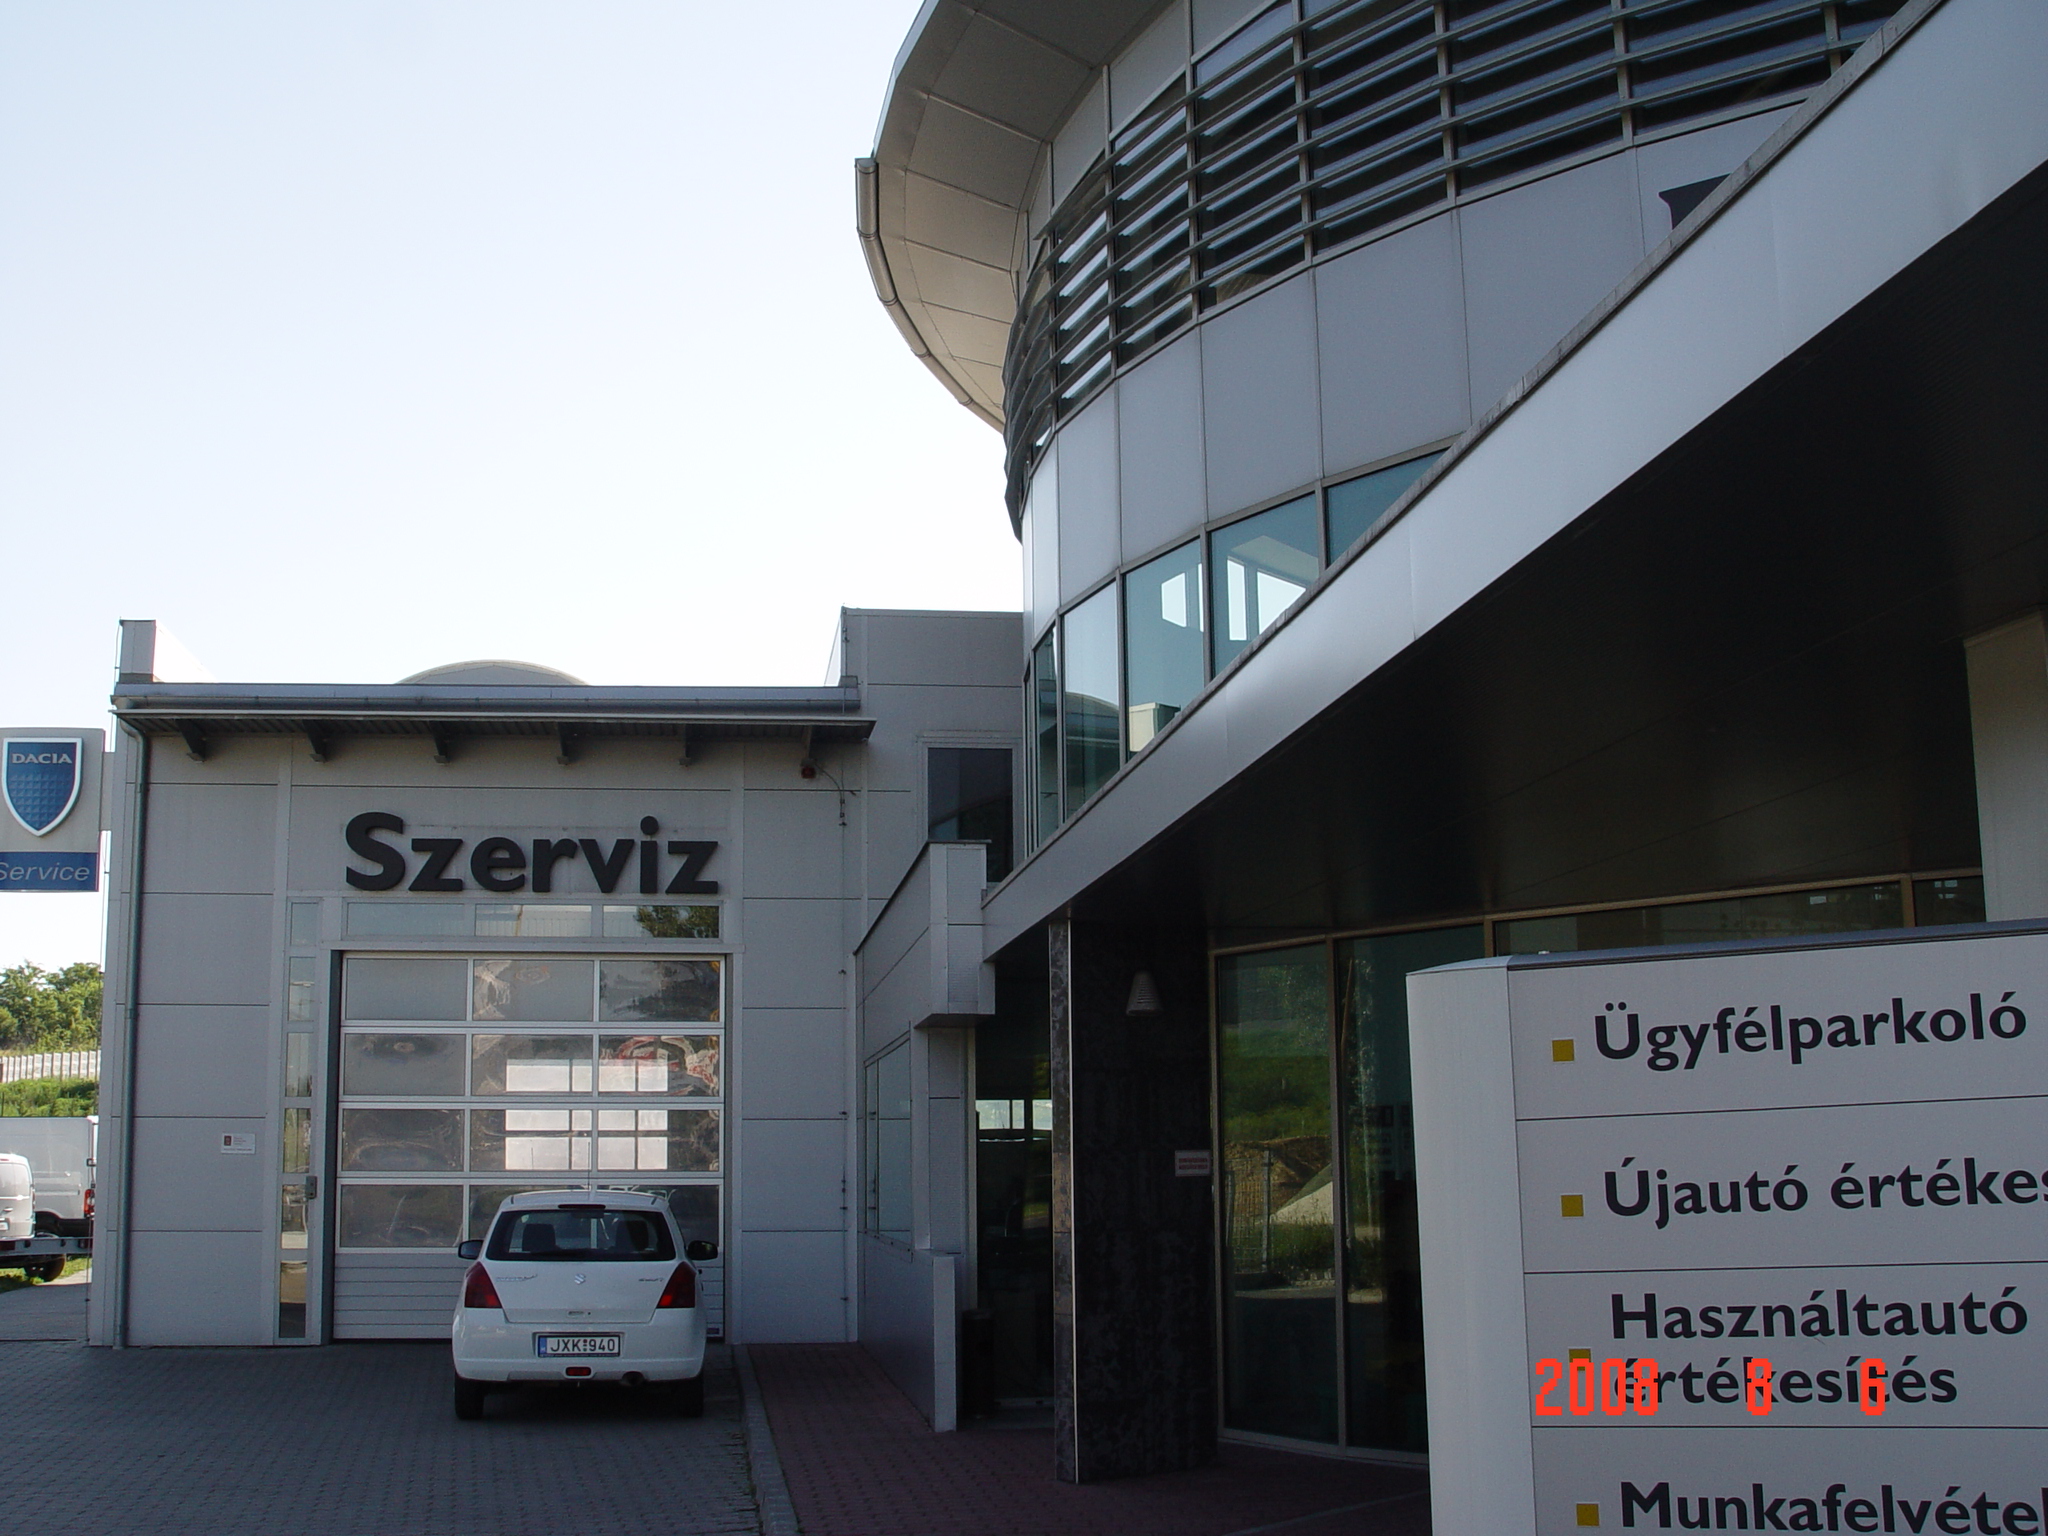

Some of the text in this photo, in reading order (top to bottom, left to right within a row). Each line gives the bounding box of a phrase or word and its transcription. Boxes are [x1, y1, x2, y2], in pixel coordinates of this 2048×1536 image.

[12, 753, 72, 764] DACIA
[0, 862, 90, 881] Service
[345, 811, 719, 894] Szerviz
[1595, 992, 2027, 1071] Ügyfélparkoló
[1604, 1157, 2048, 1229] Újautó értéke
[1611, 1287, 2028, 1339] Használtautó
